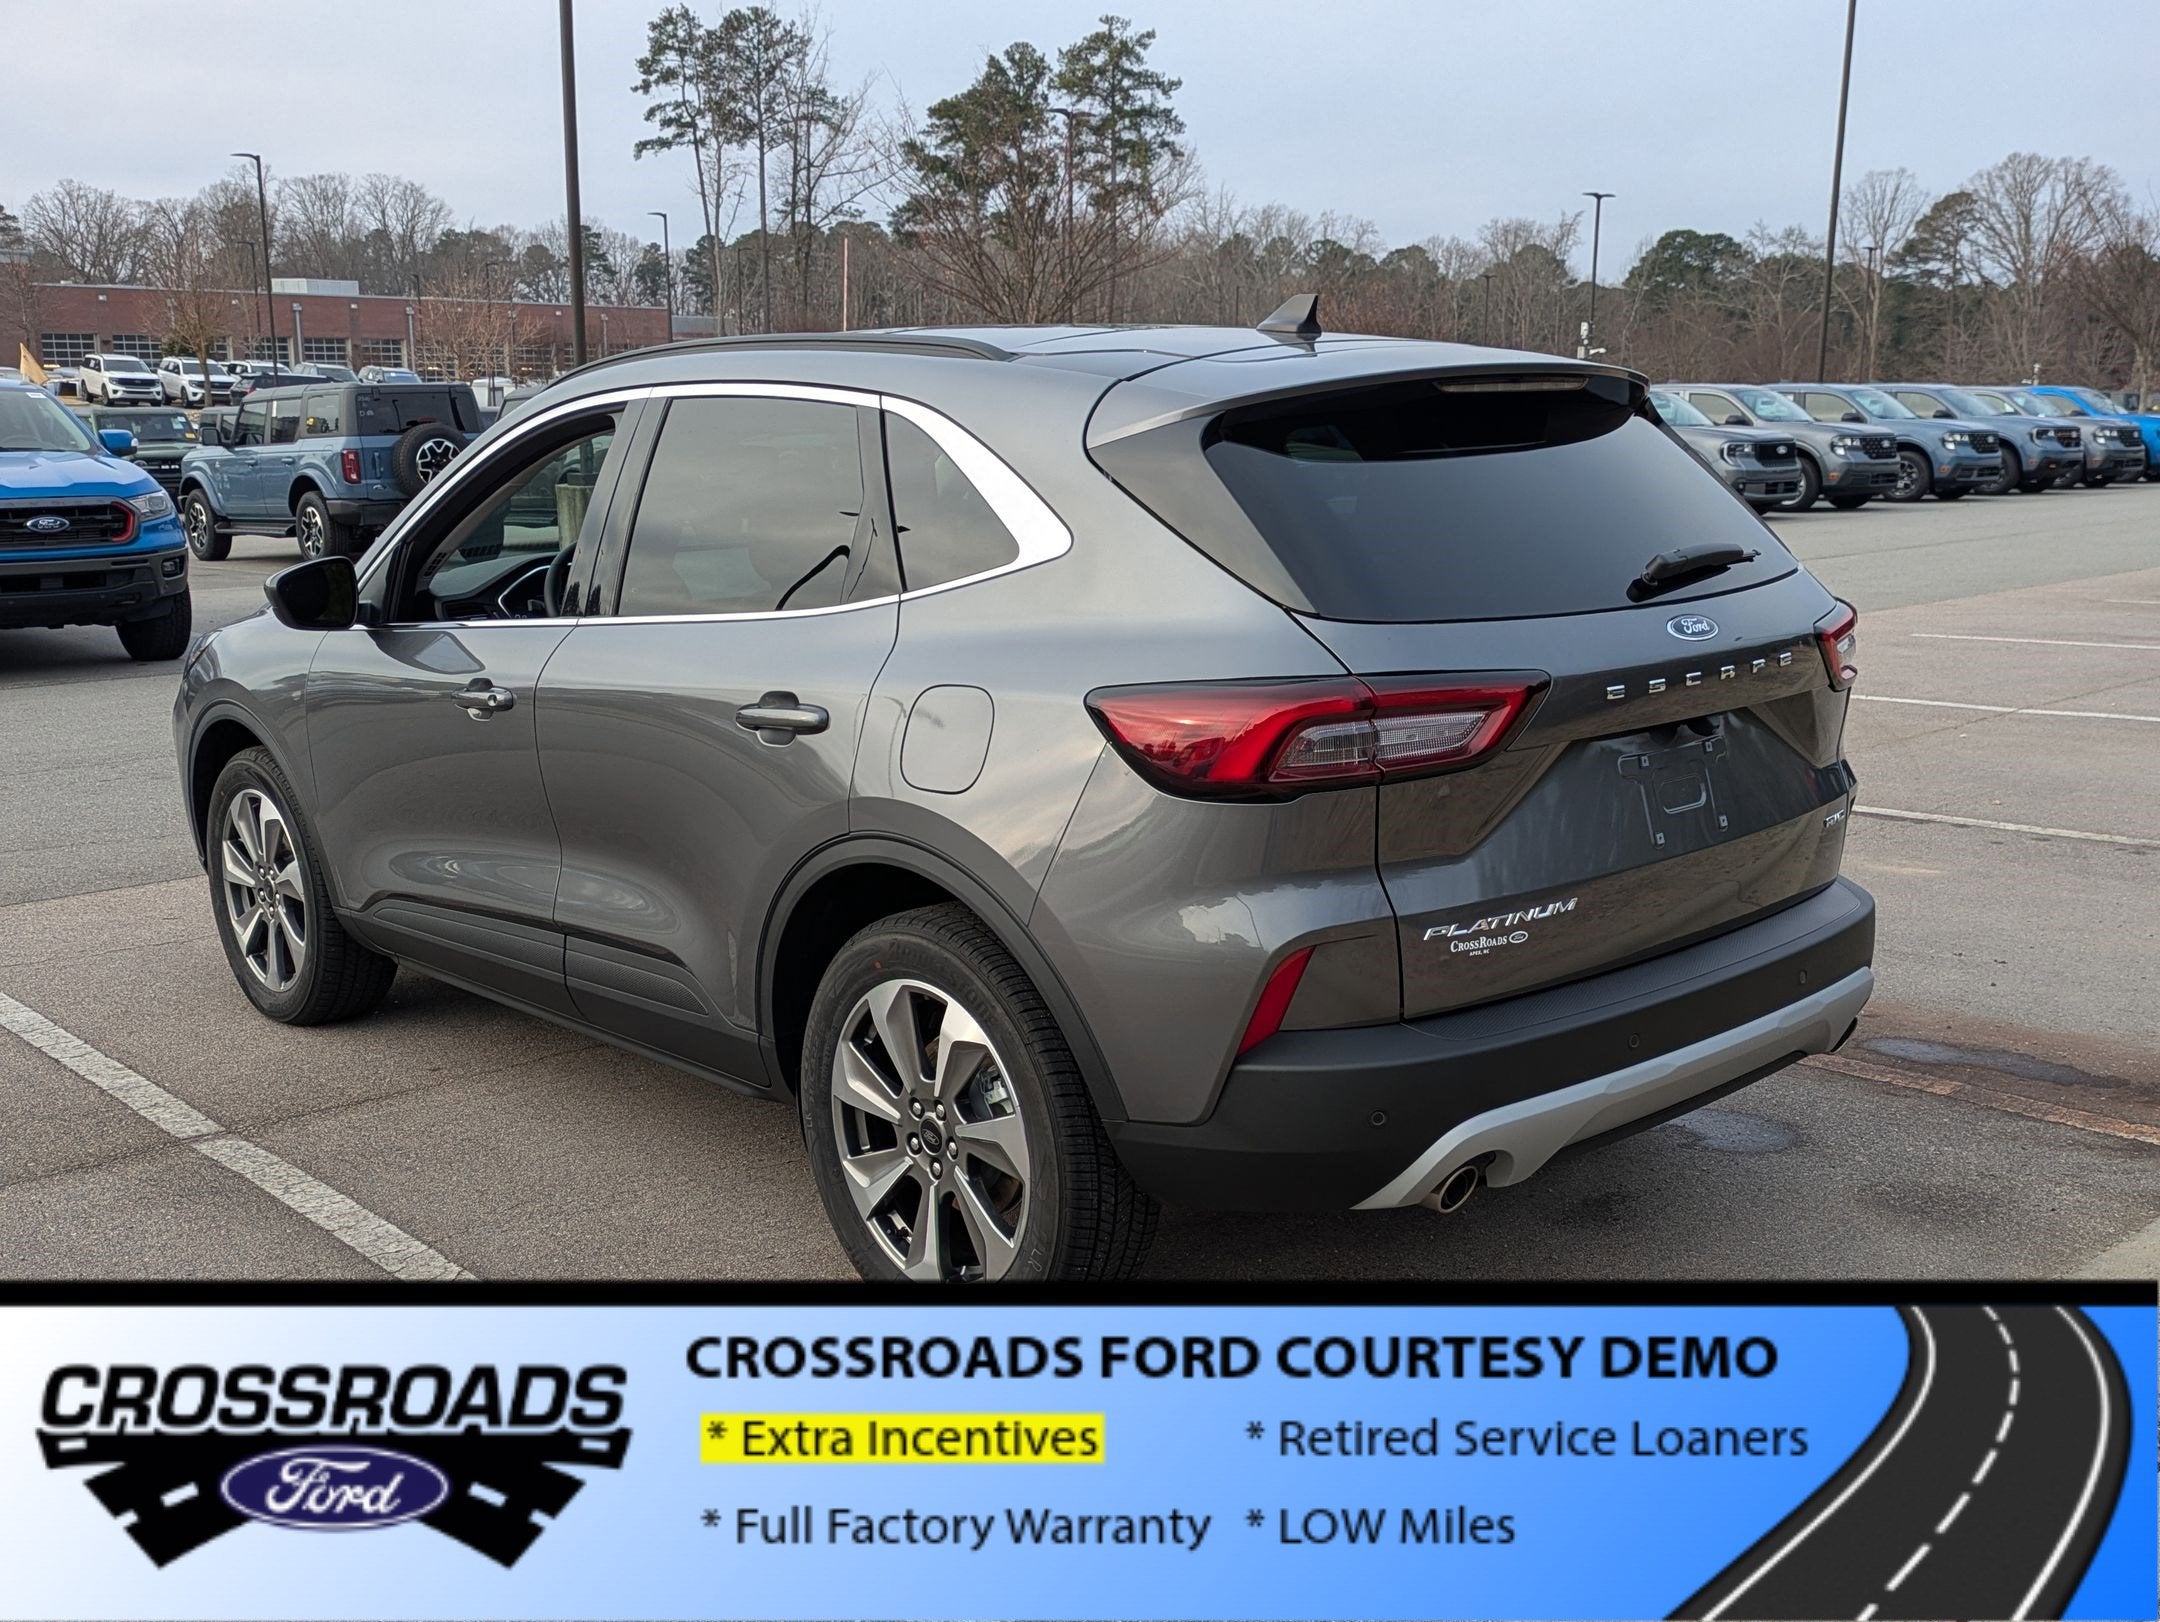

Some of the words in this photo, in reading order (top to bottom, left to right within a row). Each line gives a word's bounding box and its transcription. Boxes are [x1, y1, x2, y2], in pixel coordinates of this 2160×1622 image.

[1680, 617, 1711, 634] Ford
[1606, 652, 1793, 700] ESCAPE
[1423, 897, 1578, 941] PLATINUM
[1450, 935, 1508, 953] CROSSROADS
